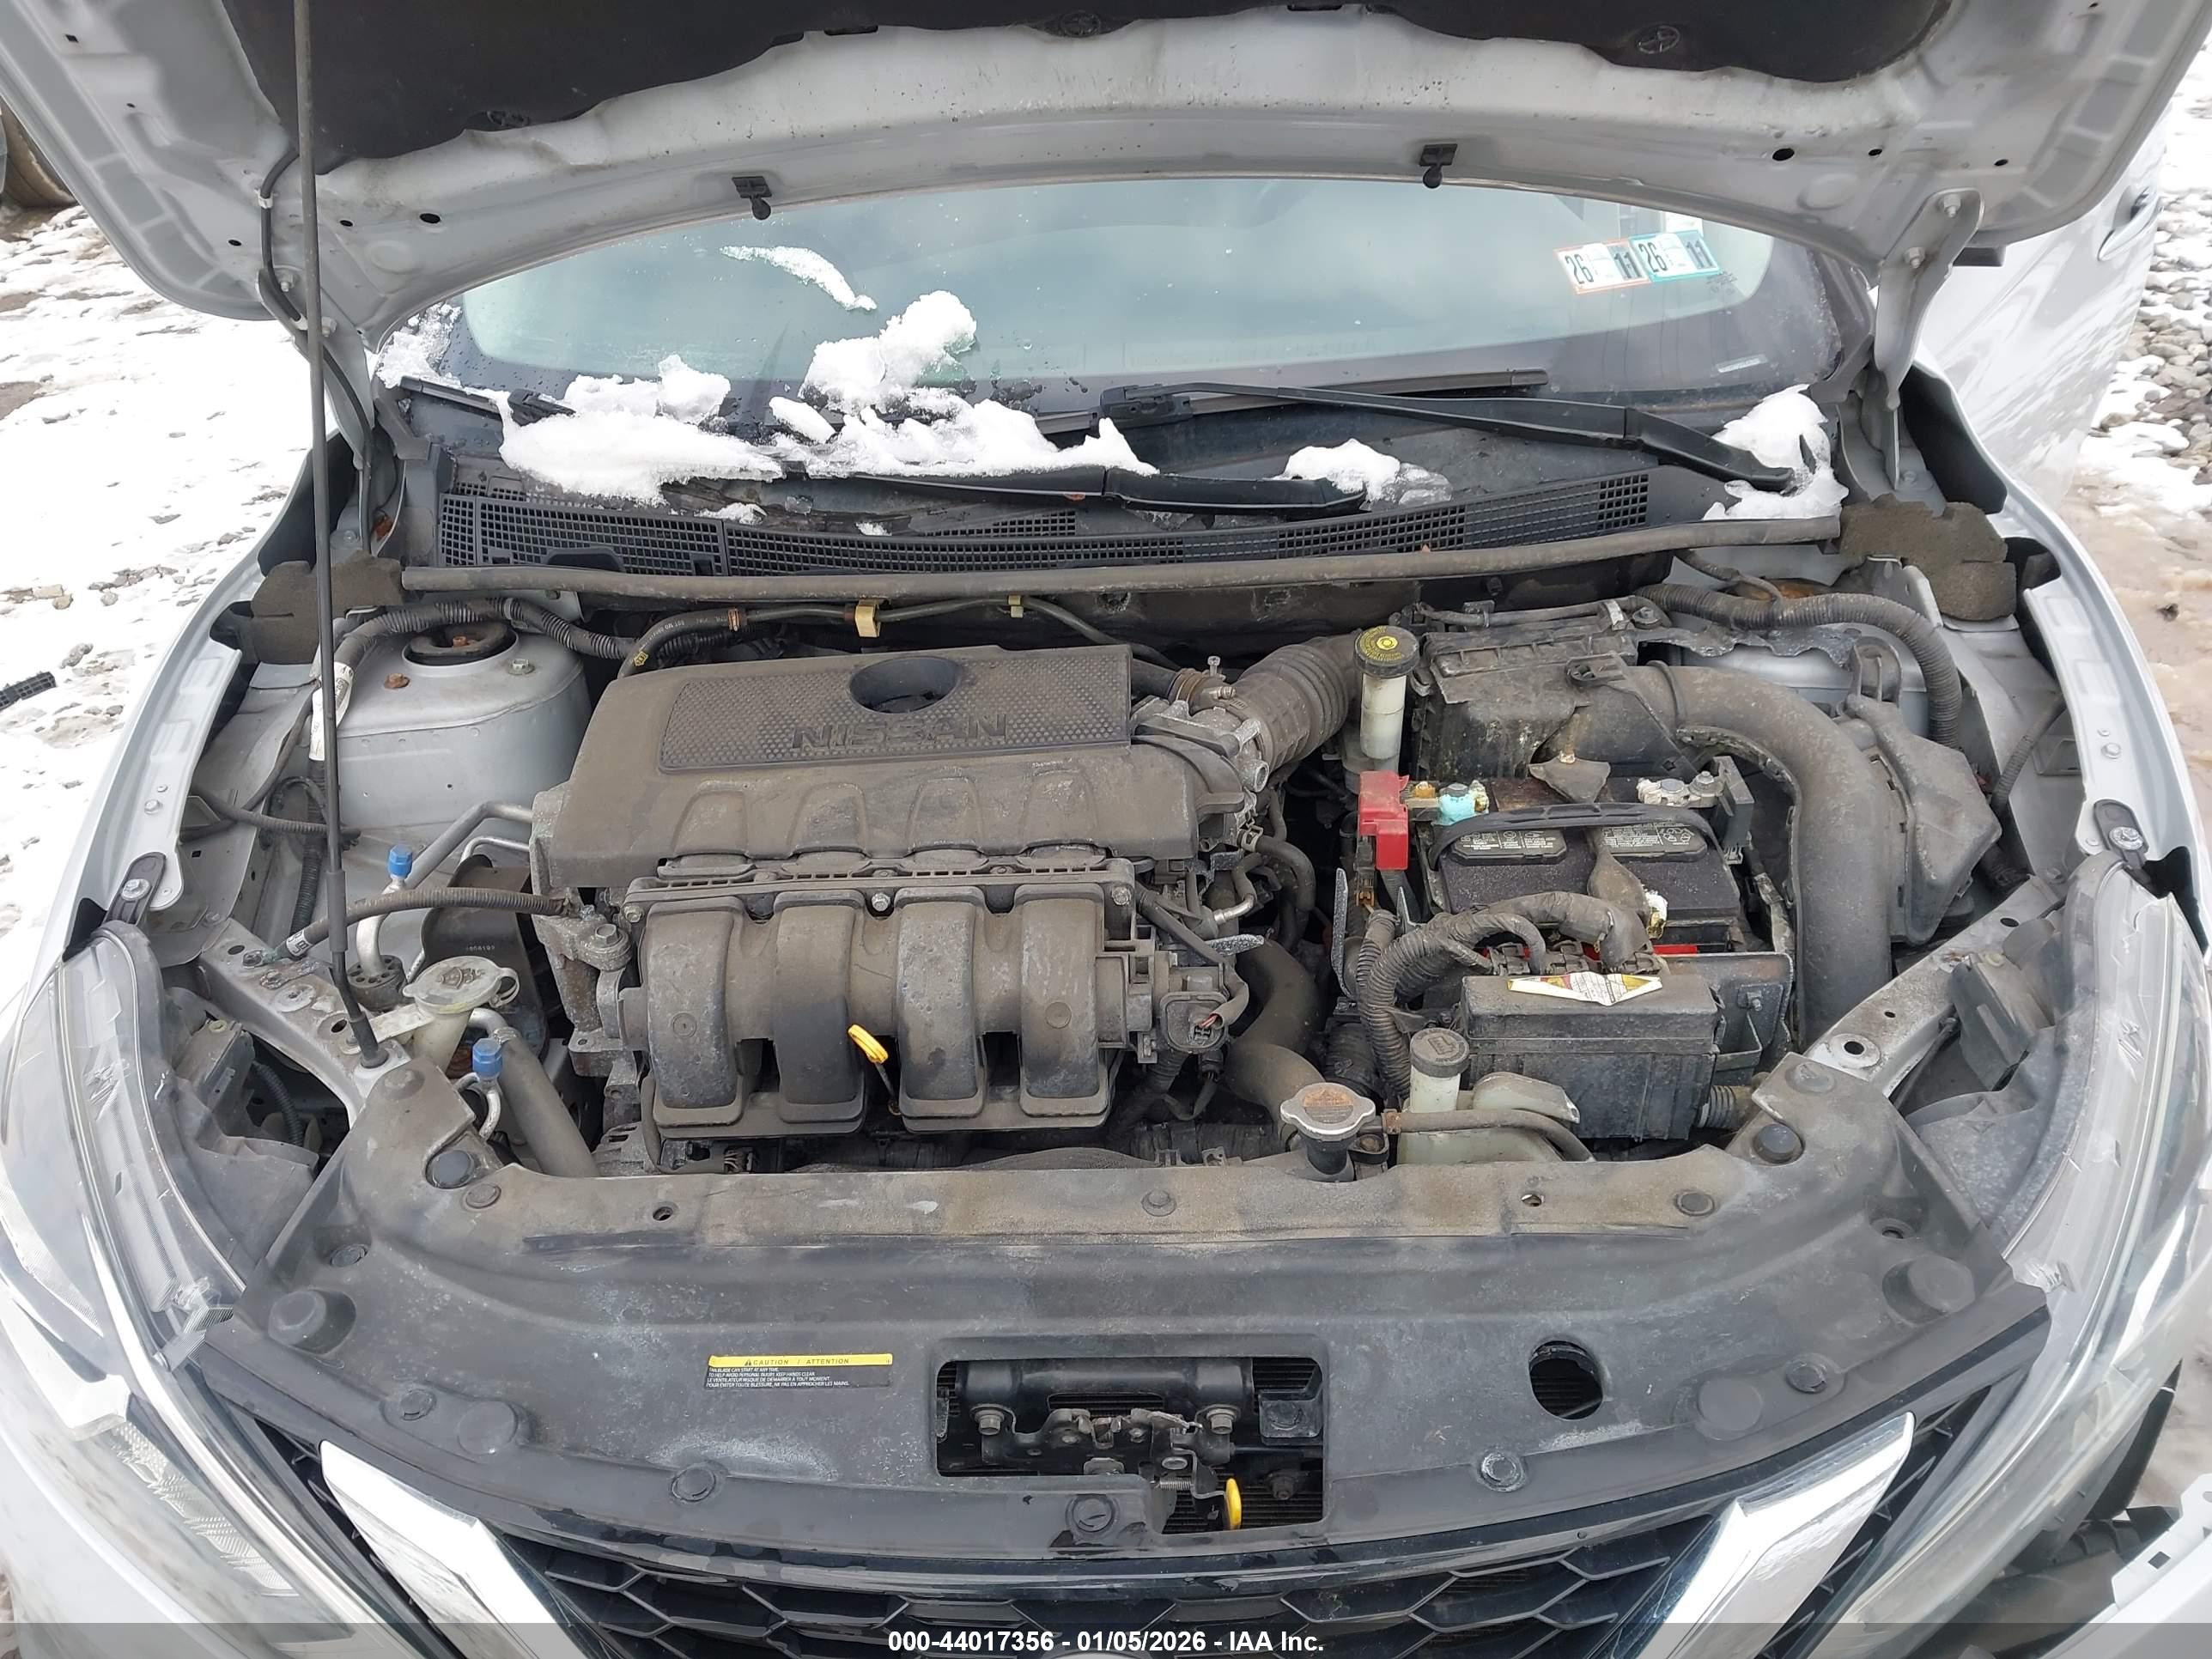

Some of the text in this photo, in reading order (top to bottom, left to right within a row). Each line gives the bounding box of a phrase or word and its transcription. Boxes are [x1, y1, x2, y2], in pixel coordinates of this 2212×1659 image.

[1565, 253, 1595, 284] 26
[1613, 252, 1644, 279] 11
[1638, 241, 1668, 272] 26
[1686, 240, 1714, 270] 11
[791, 713, 1007, 750] NISSAN
